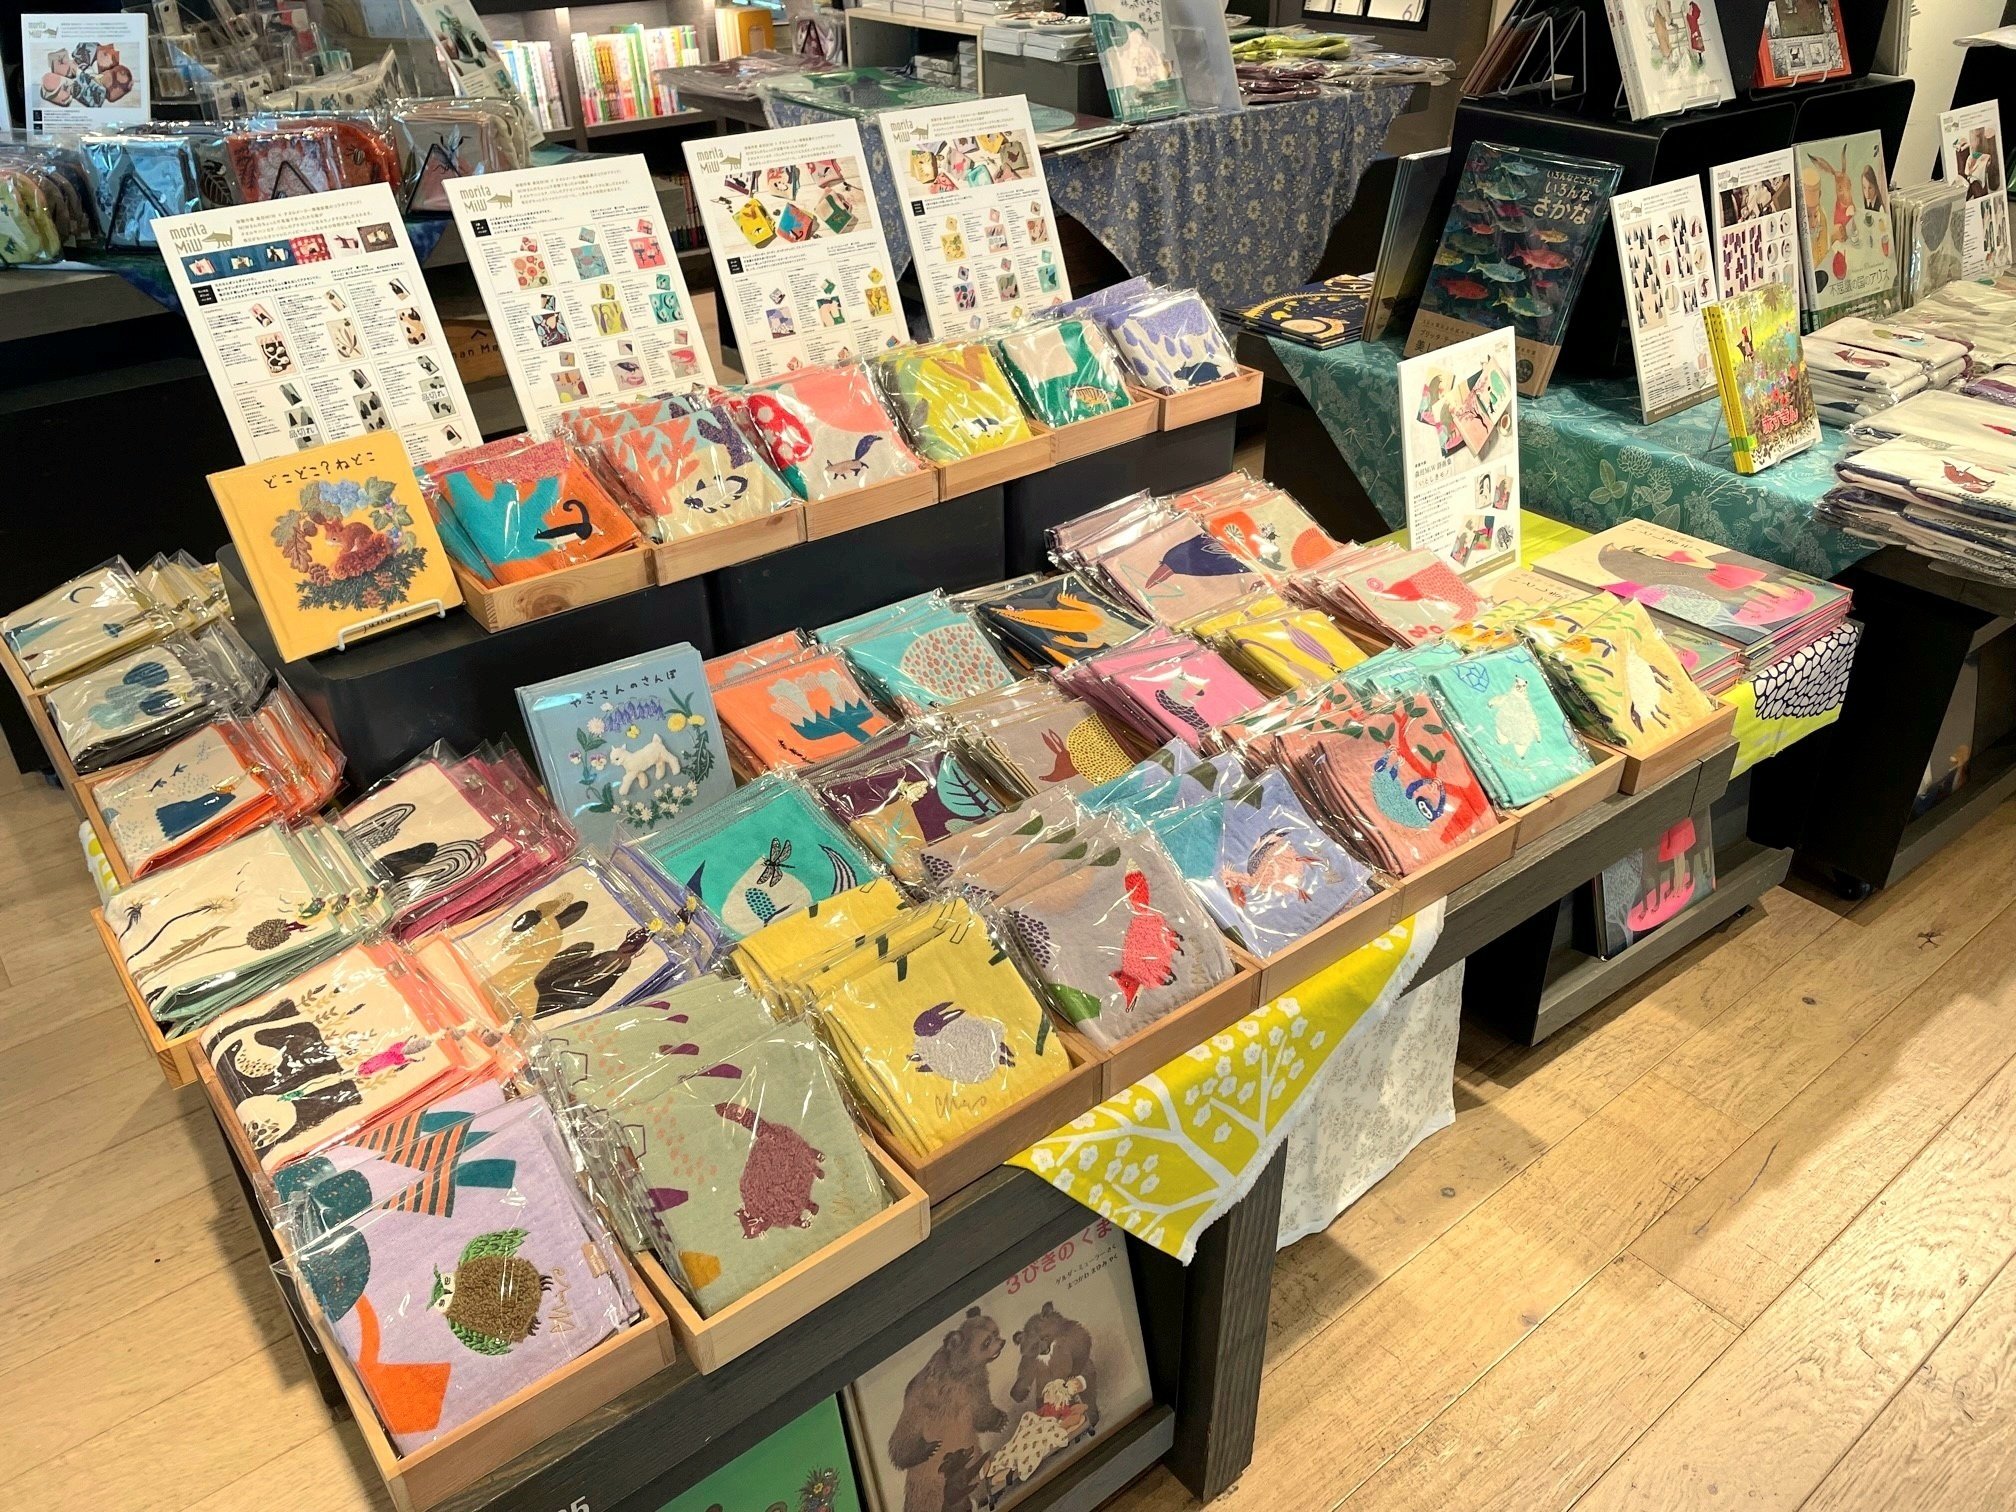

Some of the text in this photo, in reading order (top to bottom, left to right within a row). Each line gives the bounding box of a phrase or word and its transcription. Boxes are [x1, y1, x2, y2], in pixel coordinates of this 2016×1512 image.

[890, 119, 914, 131] morita
[893, 130, 911, 144] MiW
[697, 148, 724, 162] morita
[700, 161, 721, 174] MiW
[1546, 170, 1601, 187] いろんなところに
[459, 185, 492, 200] morita
[1544, 183, 1593, 202] いろんな
[464, 198, 488, 214] MiW
[1533, 195, 1592, 225] さかな
[170, 221, 208, 240] morita
[174, 236, 204, 255] MiW
[1828, 269, 1890, 297] 不思議の国のアリス
[421, 389, 447, 401] 品切れ
[288, 426, 315, 439] 品切れ
[570, 669, 677, 708] やぎさんのさんぽ
